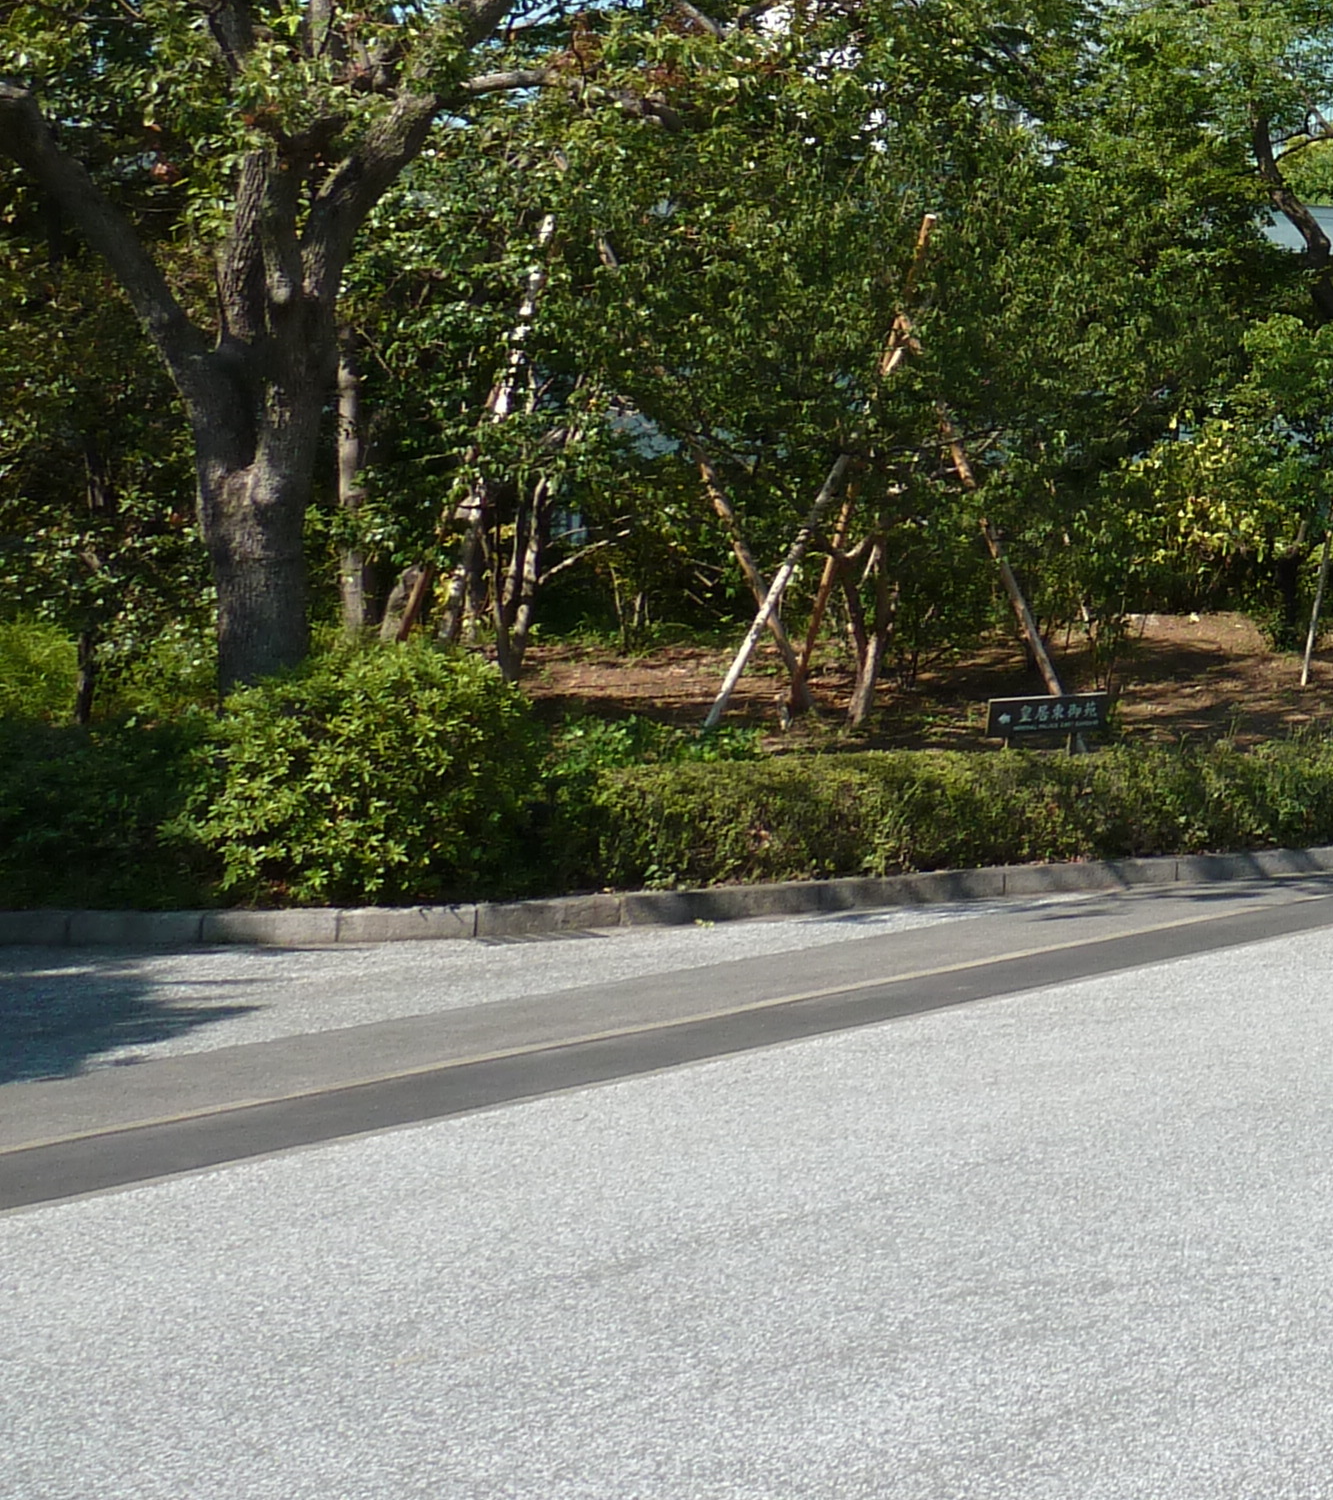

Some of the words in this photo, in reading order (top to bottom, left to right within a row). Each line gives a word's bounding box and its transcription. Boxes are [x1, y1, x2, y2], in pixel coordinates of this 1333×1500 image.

[1019, 701, 1097, 722] 皇居東御苑
